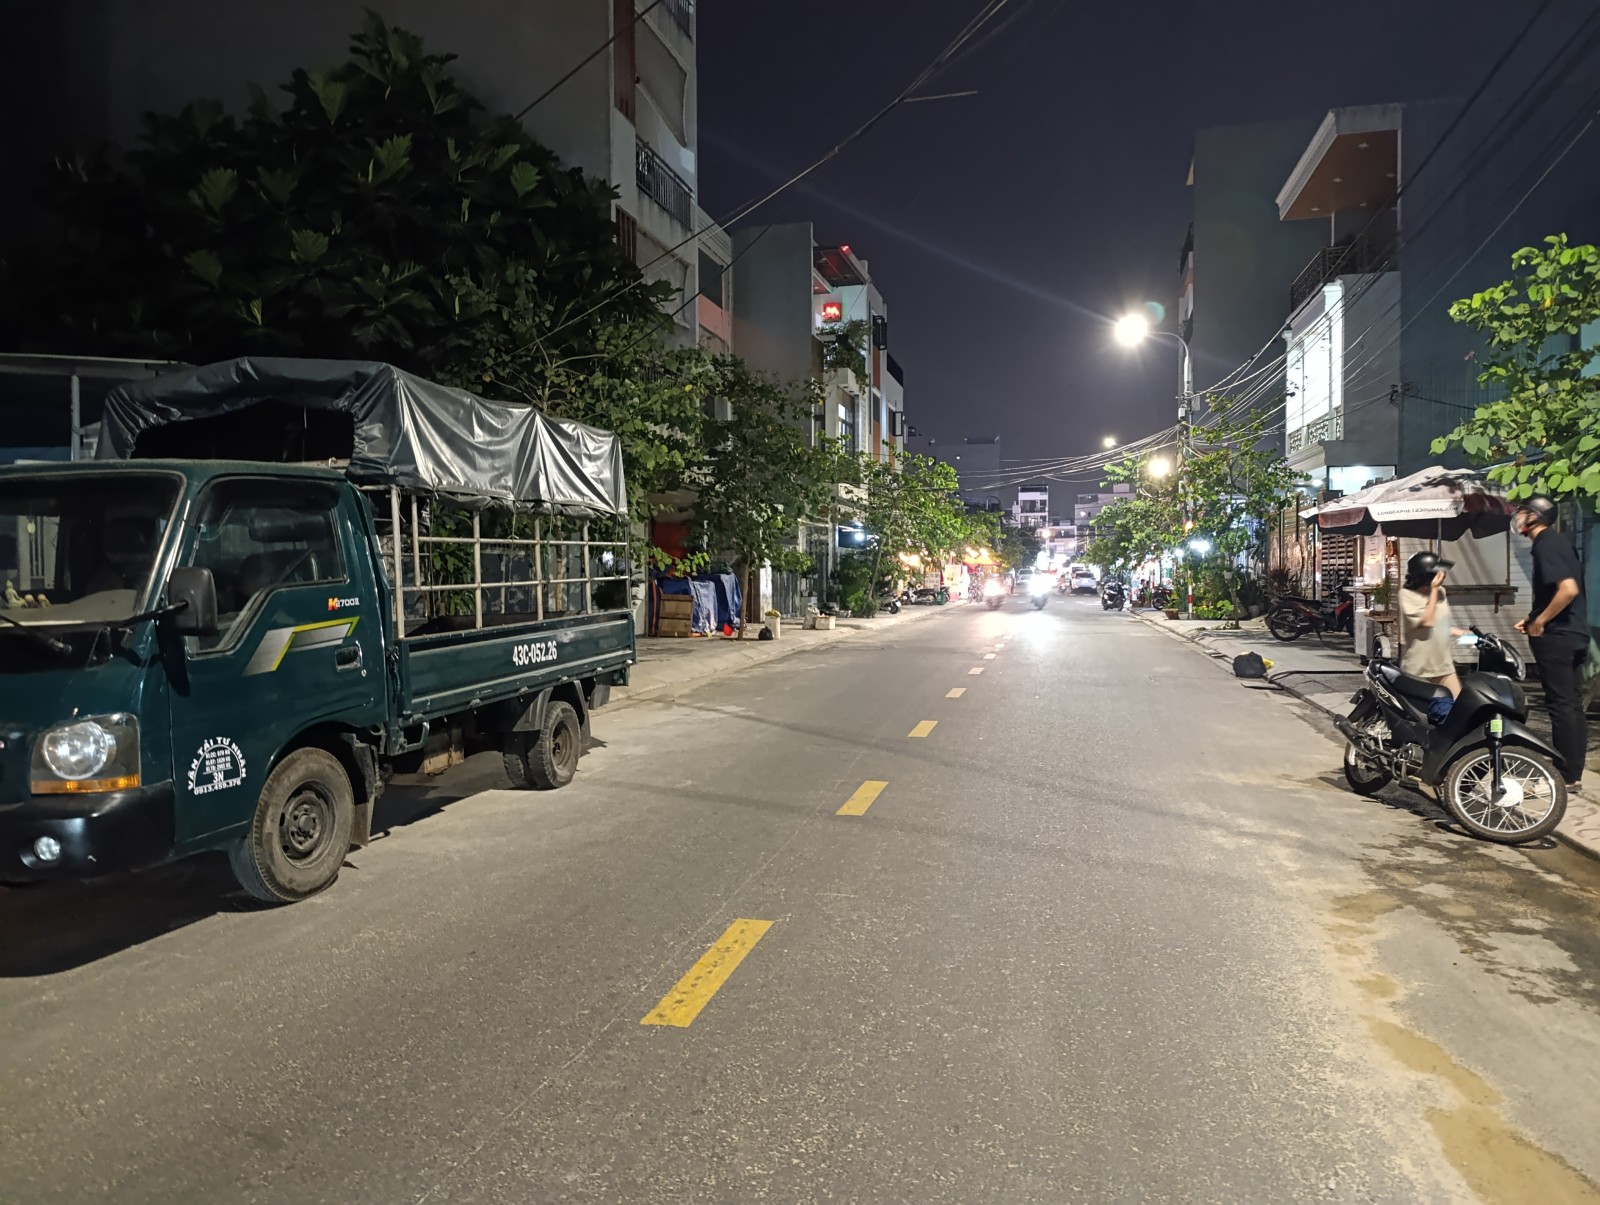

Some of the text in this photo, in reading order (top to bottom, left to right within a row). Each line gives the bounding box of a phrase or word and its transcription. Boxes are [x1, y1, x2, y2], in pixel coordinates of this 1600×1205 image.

[512, 640, 558, 667] 43C-052.26
[216, 736, 231, 746] TƯ
[213, 771, 224, 783] 3N
